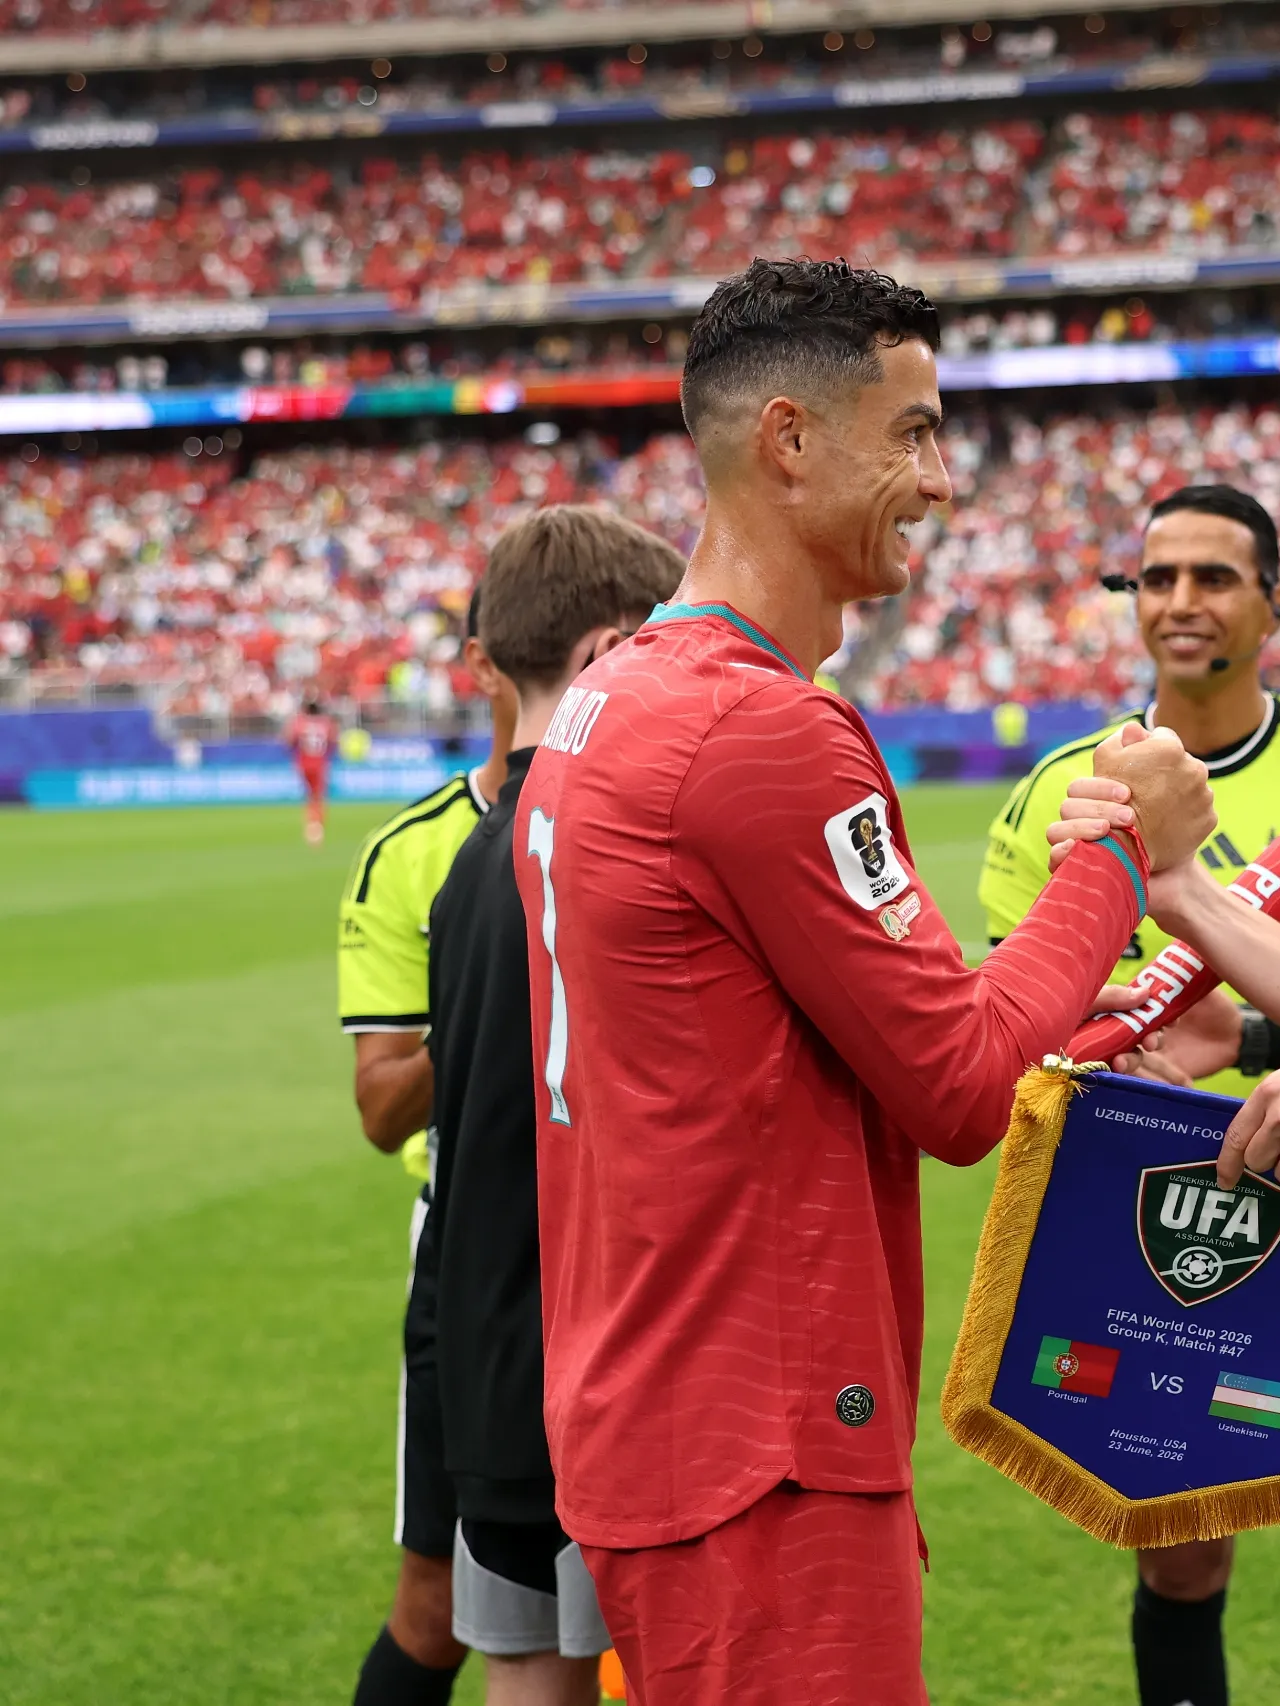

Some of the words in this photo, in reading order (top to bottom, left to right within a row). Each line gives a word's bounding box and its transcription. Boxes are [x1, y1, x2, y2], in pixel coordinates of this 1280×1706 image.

[1095, 1107, 1188, 1134] UZBEKISTAN
[1233, 1185, 1266, 1197] OTBALL
[1159, 1182, 1260, 1245] UFA
[1174, 1232, 1235, 1248] ASSOCIATION
[1107, 1308, 1138, 1324] FIFA
[1143, 1315, 1184, 1332] World
[1187, 1323, 1216, 1339] Cup
[1219, 1329, 1253, 1345] 2026
[1107, 1323, 1151, 1343] Group
[1155, 1332, 1169, 1345] K,
[1173, 1335, 1216, 1353] Match
[1219, 1343, 1245, 1358] #47
[1149, 1371, 1184, 1395] VS
[1047, 1389, 1088, 1404] Portugal
[1109, 1428, 1159, 1446] Houston,
[1163, 1438, 1188, 1451] USA
[1217, 1422, 1269, 1440] Uzbekistan
[1108, 1440, 1122, 1450] 23
[1123, 1443, 1154, 1458] June,
[1157, 1448, 1184, 1462] 2026
